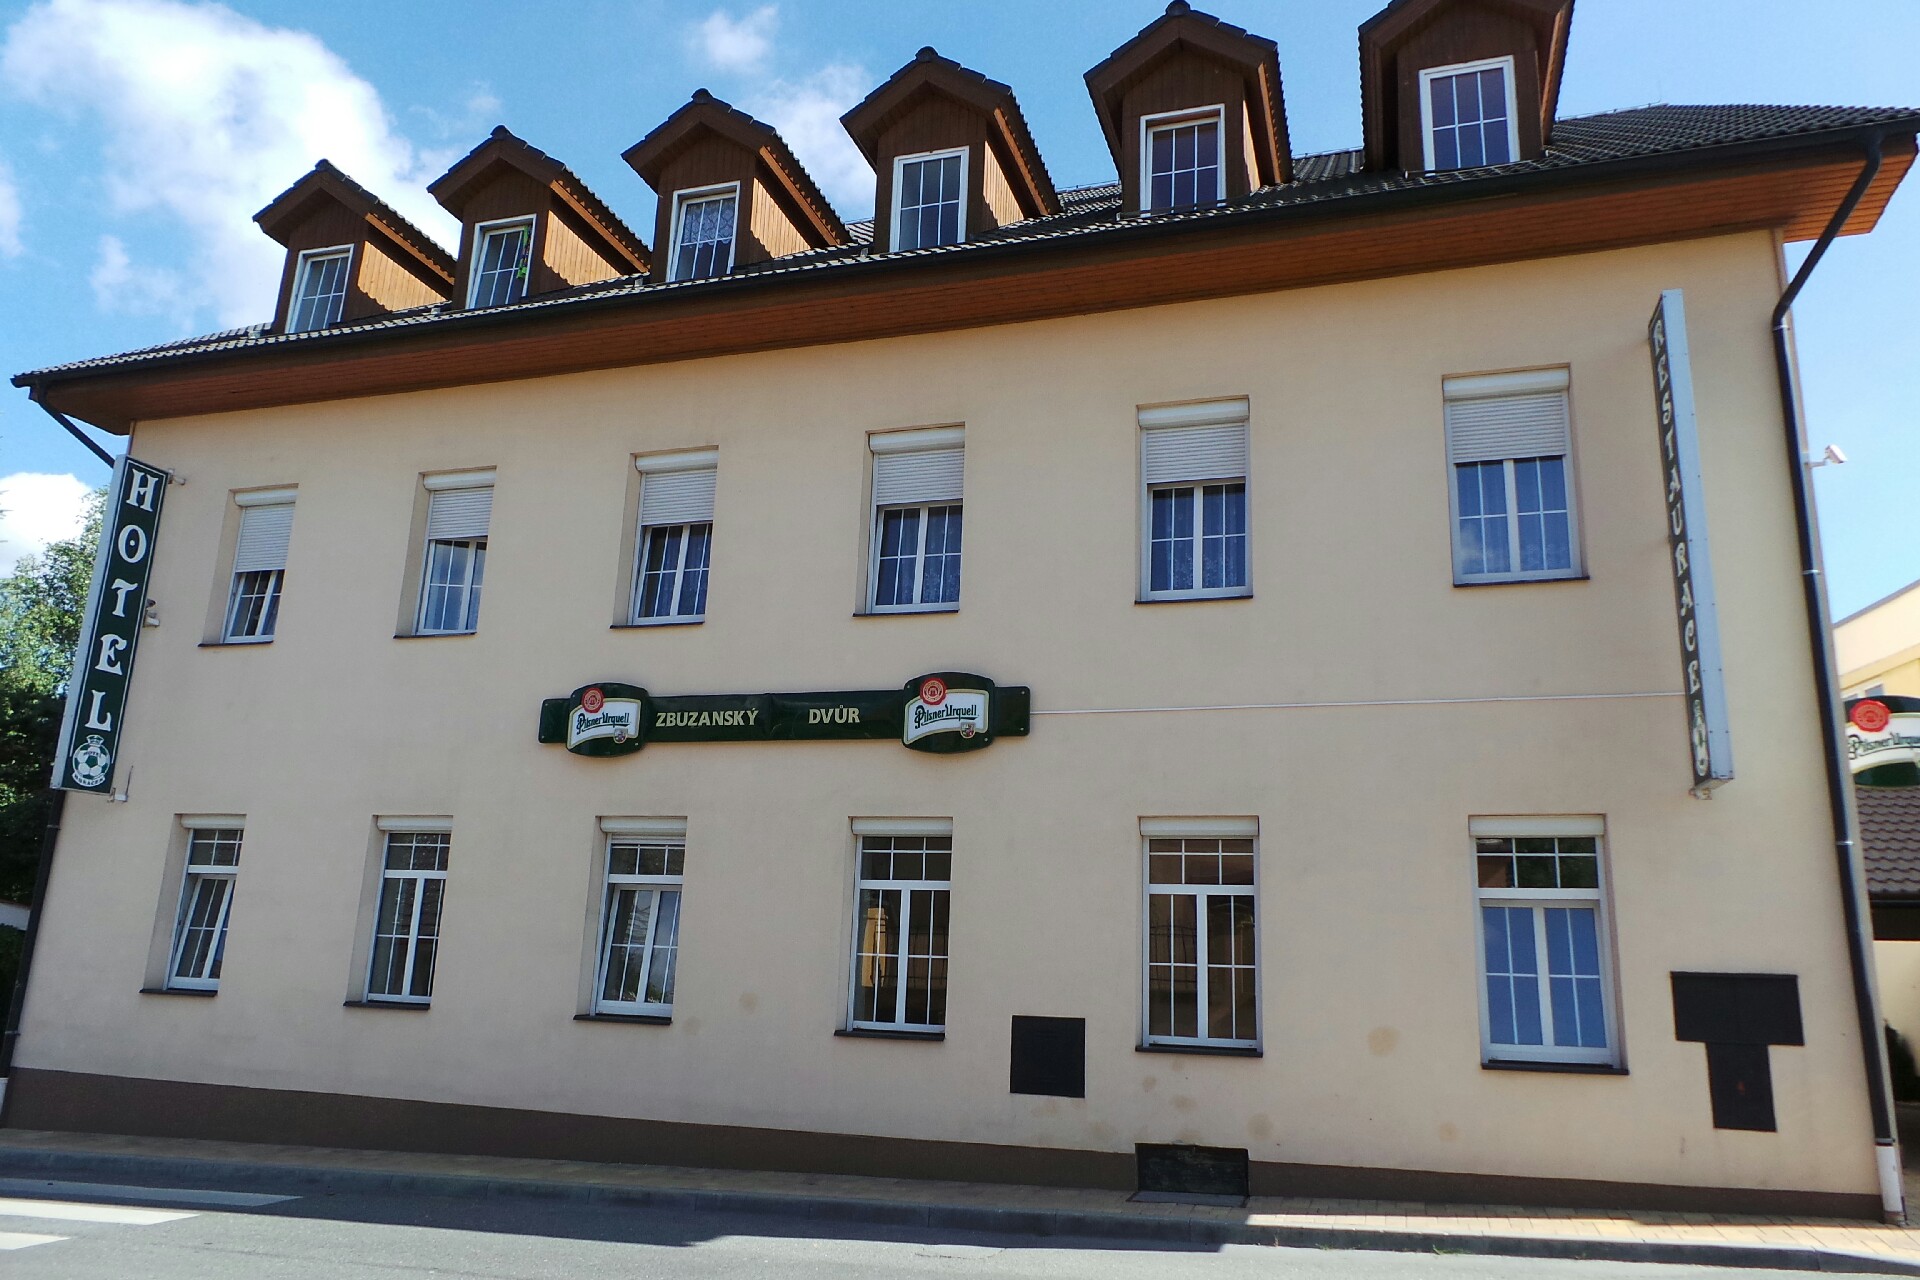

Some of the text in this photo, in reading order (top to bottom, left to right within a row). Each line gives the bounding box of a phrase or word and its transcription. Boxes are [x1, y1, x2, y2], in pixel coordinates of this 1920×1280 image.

[85, 468, 159, 731] HOTEL
[576, 711, 630, 735] Pilsner Urquell
[655, 705, 860, 727] ZBUZANSKÝ DVŮR
[914, 703, 977, 729] Pilsner Urquell
